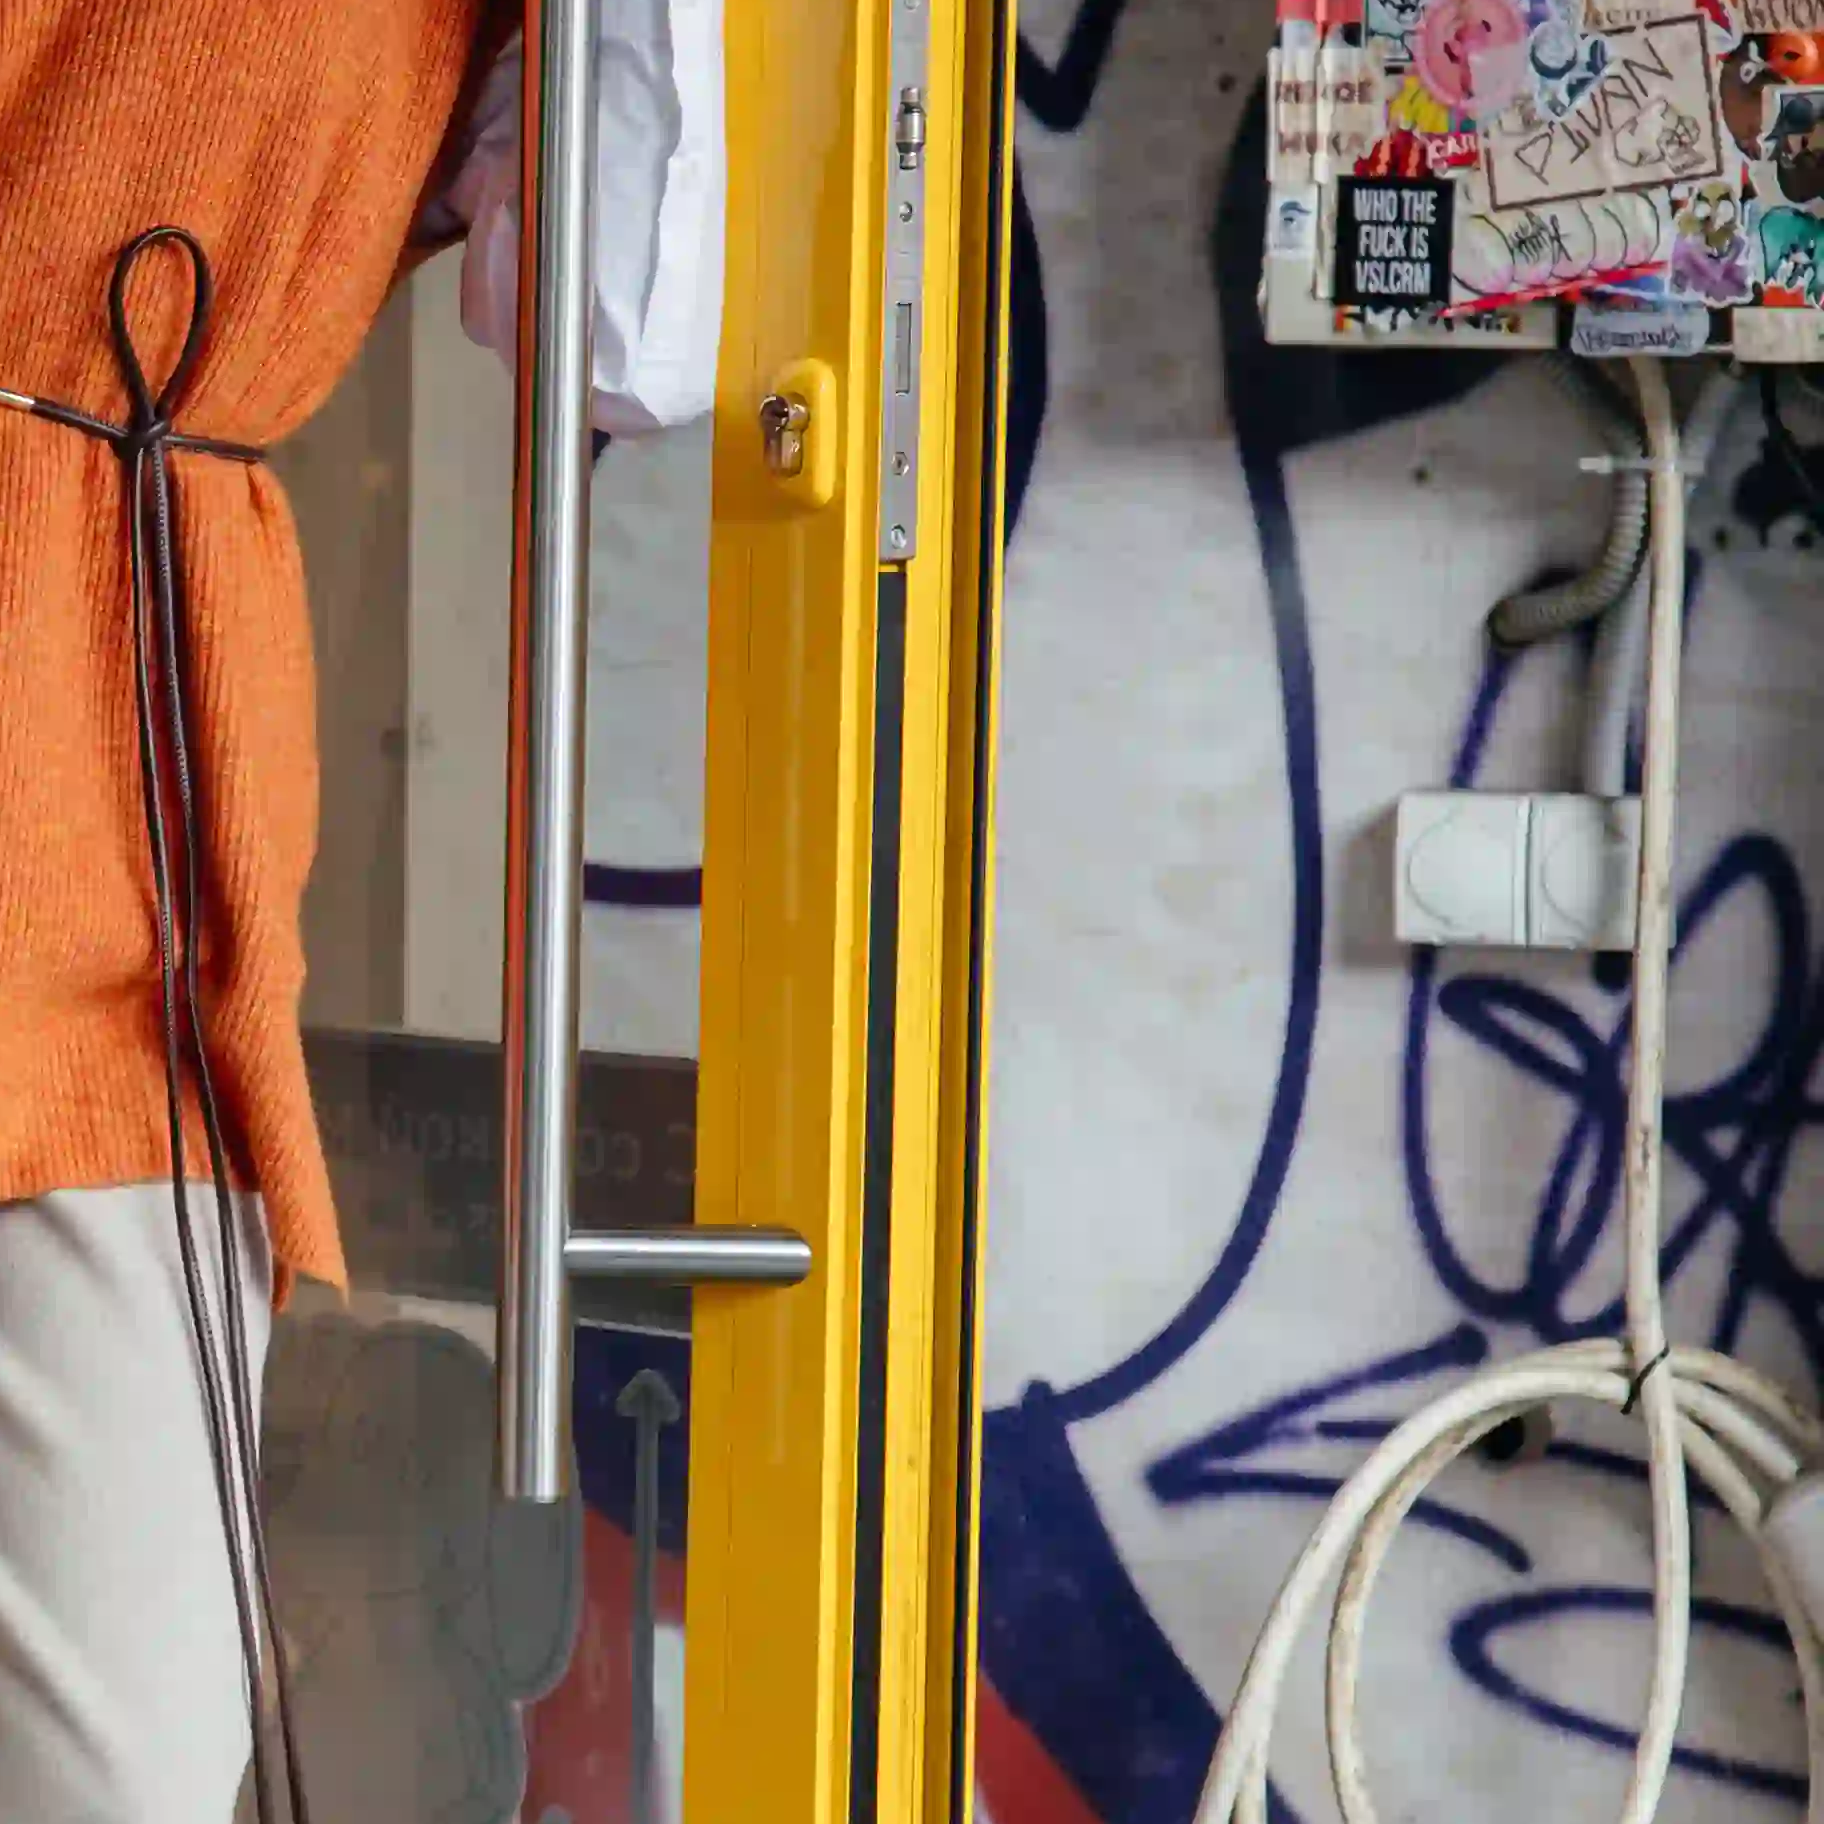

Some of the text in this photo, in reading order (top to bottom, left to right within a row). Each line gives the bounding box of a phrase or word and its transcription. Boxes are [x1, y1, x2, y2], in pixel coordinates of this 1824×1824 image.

[1354, 188, 1438, 224] WHO THE
[1359, 224, 1430, 260] FUCK IS
